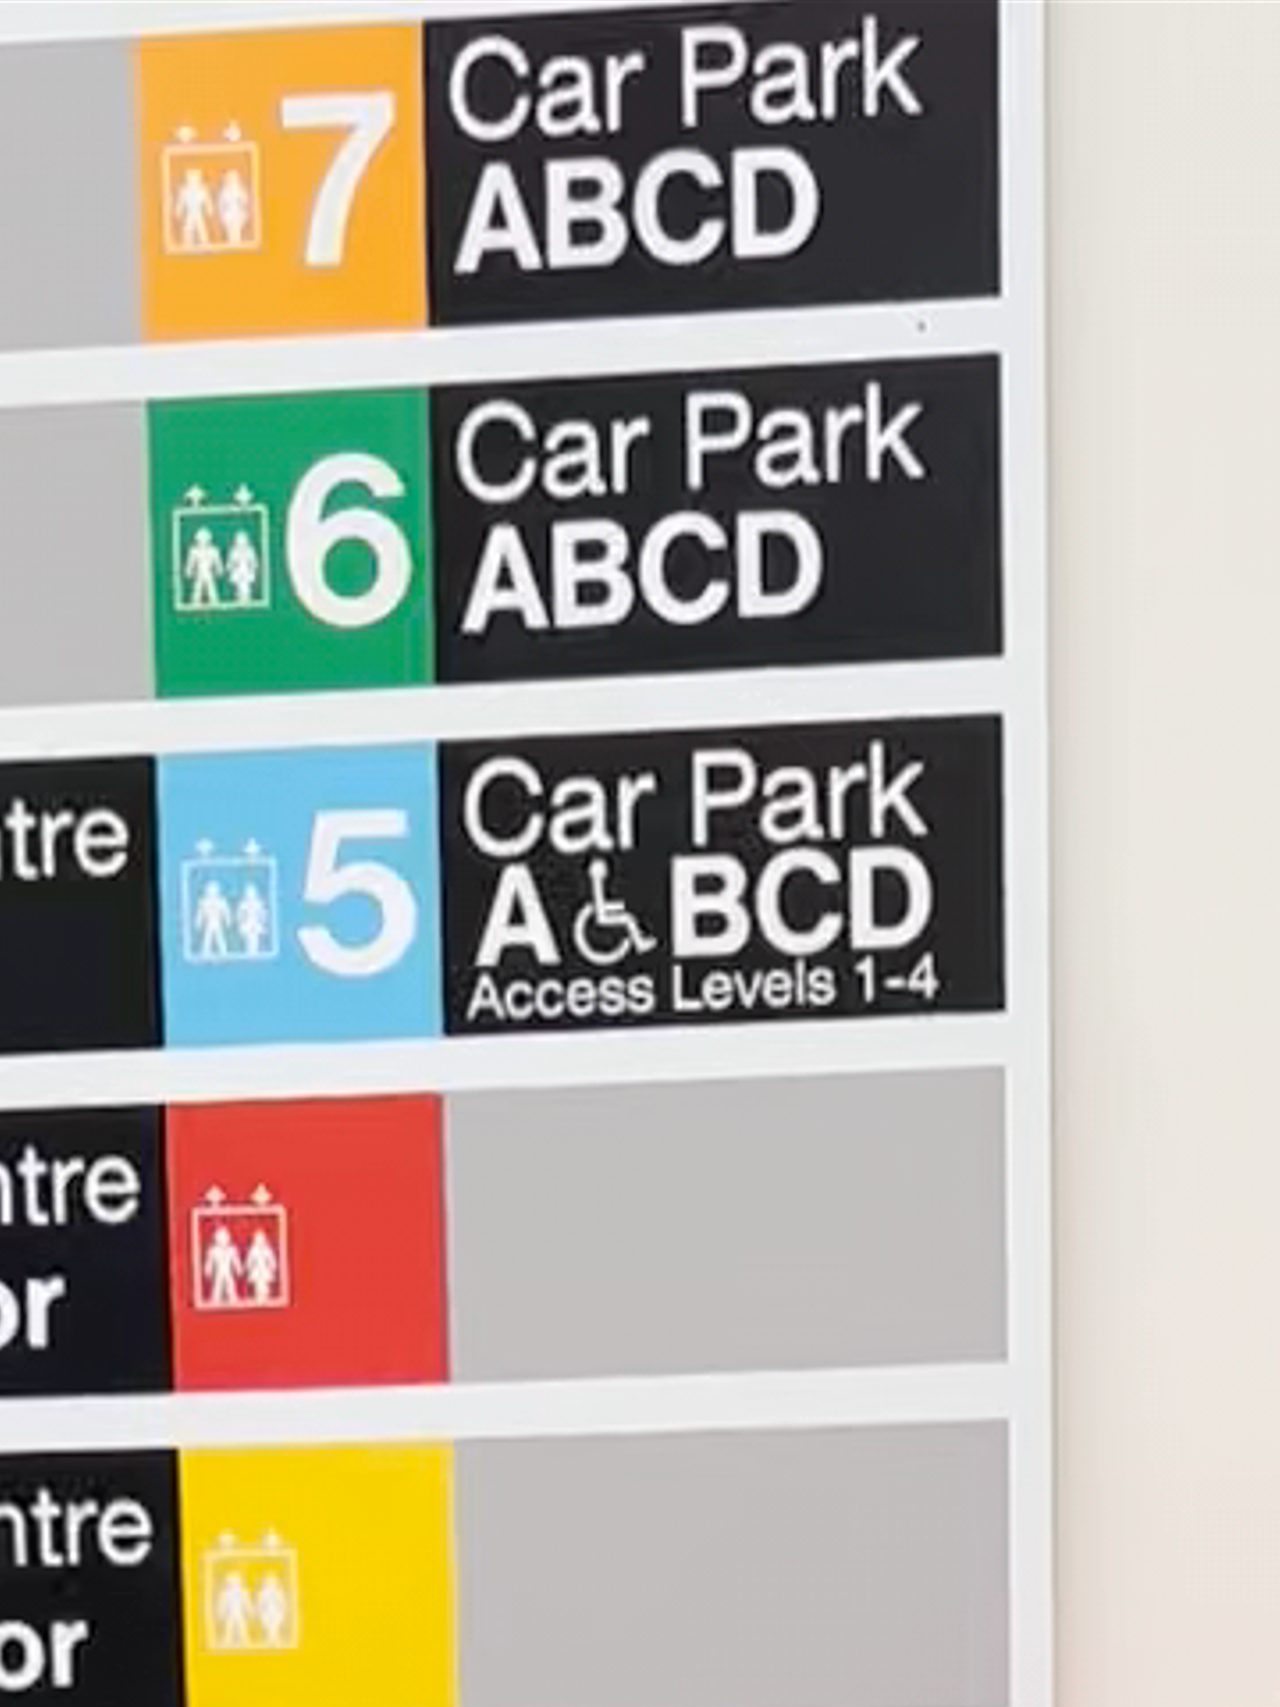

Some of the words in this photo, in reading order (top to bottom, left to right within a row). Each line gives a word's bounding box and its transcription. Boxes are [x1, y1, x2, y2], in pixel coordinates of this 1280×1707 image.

[450, 36, 643, 140] Car
[682, 16, 920, 126] Park
[277, 90, 397, 269] 7
[455, 147, 818, 272] ABCD
[457, 401, 649, 502] Car
[687, 382, 923, 489] Park
[286, 453, 411, 628] 6
[463, 511, 821, 632] ABCD
[465, 758, 655, 856] Car
[693, 741, 926, 845] Park
[297, 811, 417, 977] 5
[476, 864, 559, 966] A
[672, 847, 931, 956] BCD
[468, 974, 654, 1018] Access
[674, 960, 835, 1010] Levels
[856, 954, 938, 1001] 1-4
